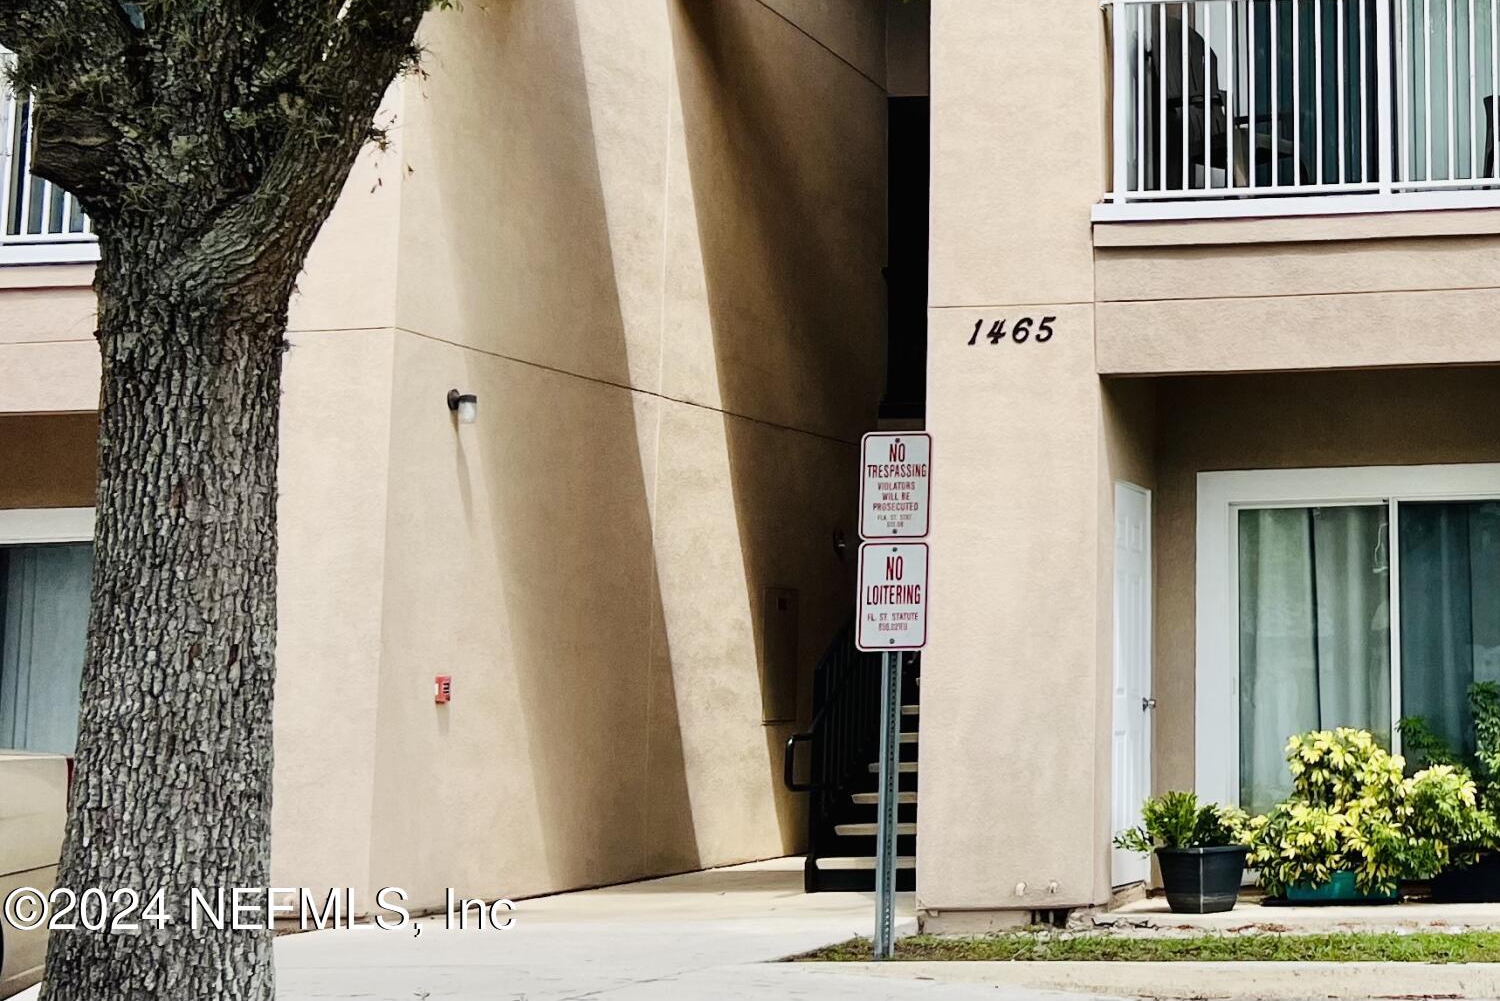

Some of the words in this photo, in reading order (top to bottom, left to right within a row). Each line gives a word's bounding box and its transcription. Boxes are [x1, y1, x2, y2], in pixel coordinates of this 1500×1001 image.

[968, 316, 1056, 345] 1465
[889, 443, 905, 462] NO
[867, 464, 927, 478] TRESPASSING
[878, 482, 915, 490] VIOLATORS
[882, 493, 898, 501] WILL
[902, 492, 910, 501] BE
[873, 502, 918, 511] PROSECUTED
[886, 556, 903, 580] NO
[867, 585, 921, 605] LOITERING
[892, 612, 918, 621] STATUTE
